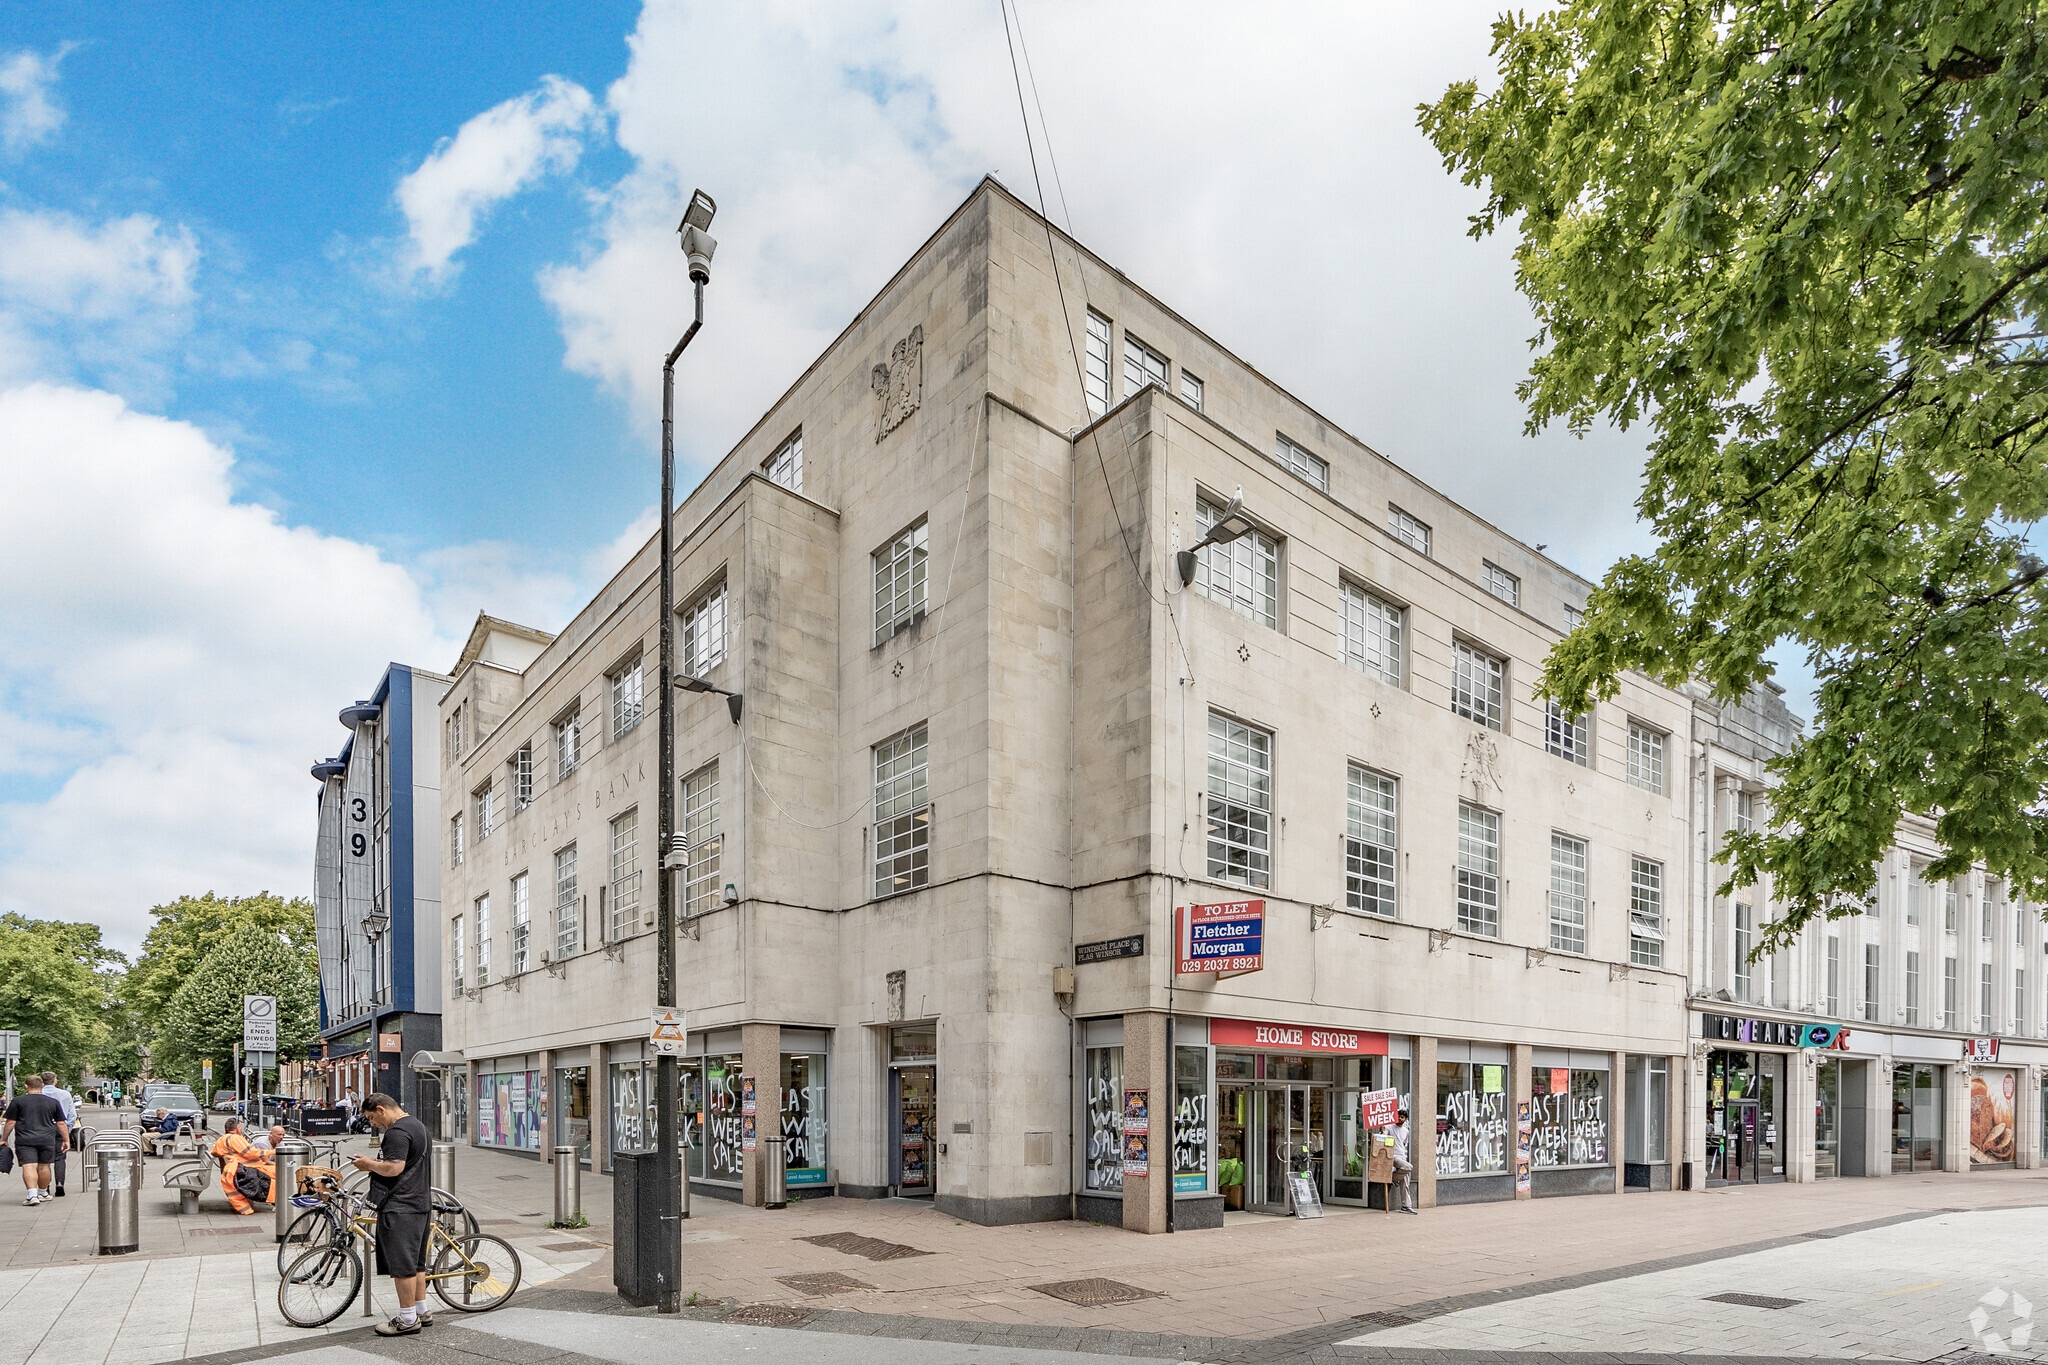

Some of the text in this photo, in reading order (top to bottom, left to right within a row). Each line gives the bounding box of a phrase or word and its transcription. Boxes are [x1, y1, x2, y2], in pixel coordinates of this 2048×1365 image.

[504, 761, 645, 866] BARCLAYS BANK
[1204, 903, 1248, 916] TO LET
[1194, 924, 1250, 939] Fletcher
[1077, 940, 1130, 954] WINDSOR PLACE
[1078, 949, 1121, 961] PLAS WINSOR
[1192, 942, 1245, 956] Morgan
[1181, 957, 1259, 973] 029 2037 8921
[1256, 1026, 1358, 1049] HOME STORE
[1722, 1017, 1797, 1045] CREAMS
[1831, 1029, 1850, 1050] FC
[1217, 1065, 1233, 1075] AST
[613, 1076, 641, 1109] LAST
[647, 1073, 691, 1110] LT
[710, 1074, 743, 1113] LAS
[780, 1086, 825, 1114] LAST
[1364, 1090, 1395, 1102] SALE SALE SALE
[1174, 1094, 1206, 1125] AST
[1369, 1101, 1393, 1115] LAST
[1446, 1090, 1470, 1122] AST
[1472, 1089, 1505, 1120] LAST
[1532, 1092, 1564, 1125] AST
[1572, 1095, 1603, 1120] LAST
[615, 1111, 642, 1140] WEEK
[711, 1113, 742, 1149] WEE
[782, 1115, 828, 1138] WEEK
[1091, 1109, 1123, 1131] WEE
[1367, 1111, 1396, 1127] WEEK
[1474, 1117, 1507, 1140] WEEK
[1573, 1120, 1606, 1138] WEEK
[713, 1141, 743, 1174] SALE
[785, 1137, 825, 1167] SALE
[1174, 1146, 1206, 1171] SALE
[1475, 1138, 1504, 1170] SALE
[1534, 1148, 1559, 1167] SALE
[1574, 1136, 1604, 1161] SALE
[1436, 1156, 1466, 1175] SALE
